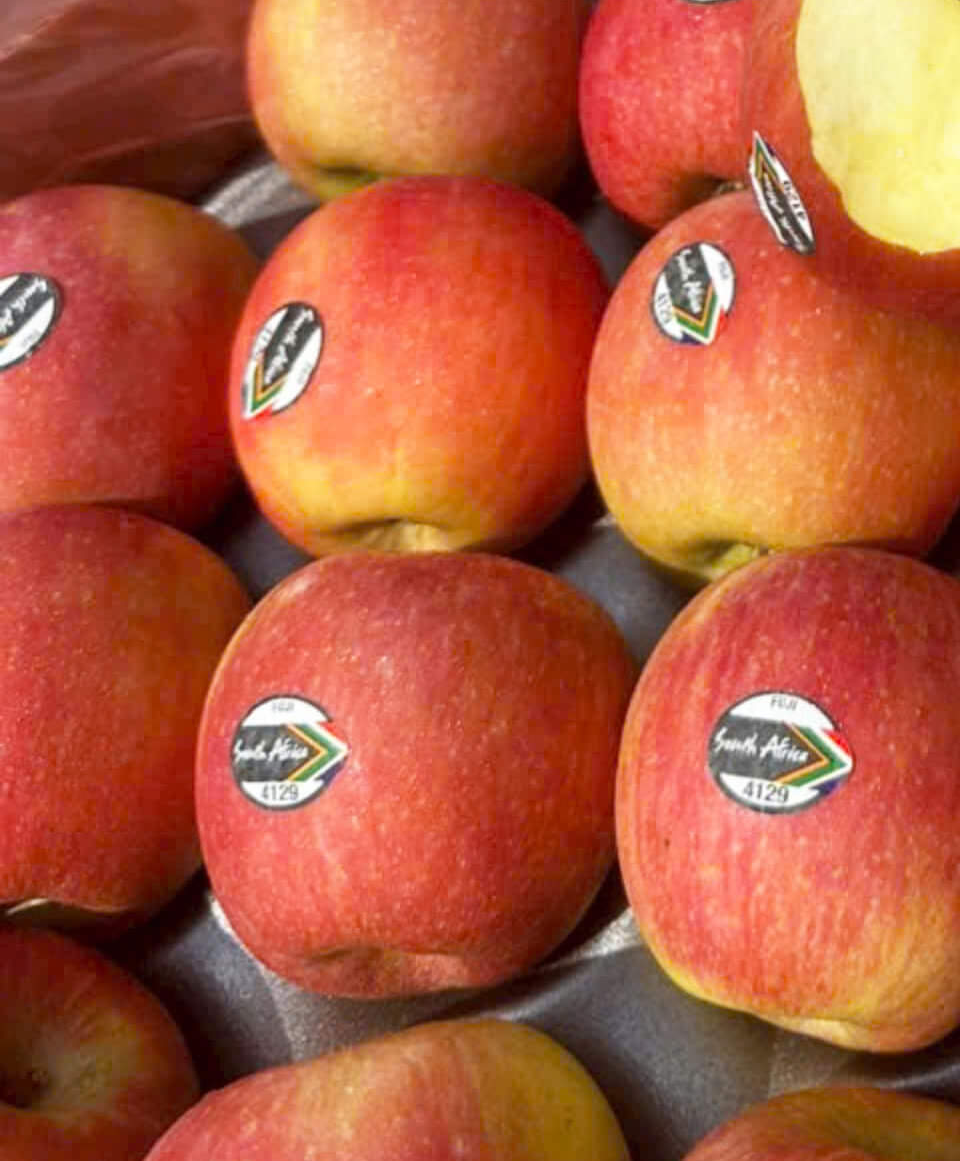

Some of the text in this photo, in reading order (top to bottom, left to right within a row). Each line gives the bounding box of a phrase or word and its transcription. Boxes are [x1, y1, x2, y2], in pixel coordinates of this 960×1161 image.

[714, 726, 809, 762] South Africa
[261, 783, 299, 801] 4129
[742, 781, 790, 803] 4129
